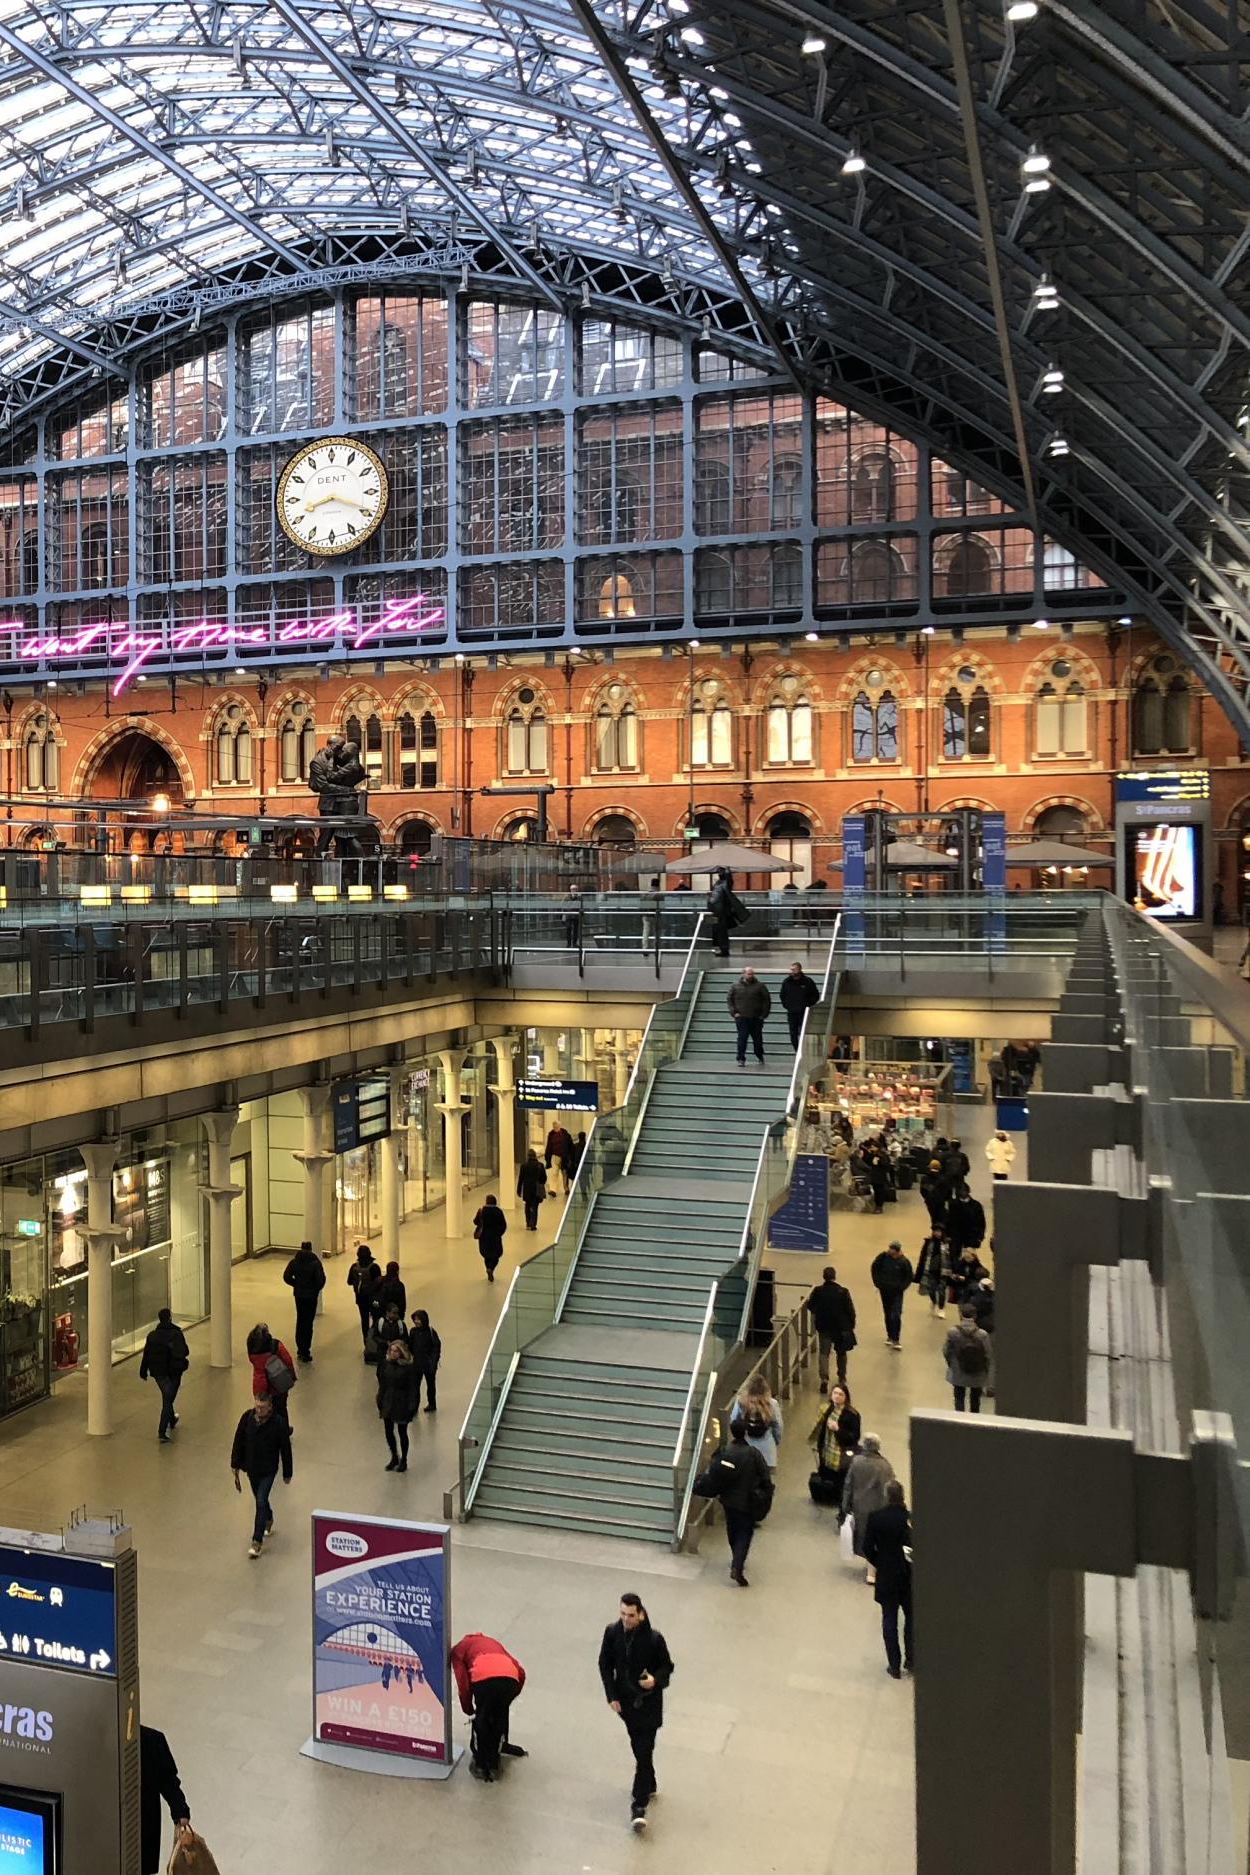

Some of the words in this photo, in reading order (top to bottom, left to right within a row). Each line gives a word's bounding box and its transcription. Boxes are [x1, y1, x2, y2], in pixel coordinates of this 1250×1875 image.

[317, 474, 347, 485] DENT
[148, 1169, 166, 1188] M&S
[331, 1536, 360, 1546] STATION
[331, 1544, 362, 1552] MATTERS
[355, 1586, 384, 1598] YOUR
[387, 1590, 432, 1604] STATION
[378, 1580, 394, 1589] TELL
[406, 1585, 430, 1594] ABOUT
[326, 1591, 431, 1619] EXPERIENCE
[34, 1638, 86, 1664] Toilets
[328, 1695, 362, 1714] WIN
[368, 1702, 382, 1717] A
[388, 1706, 432, 1726] £150
[0, 1843, 26, 1856] STAGE
